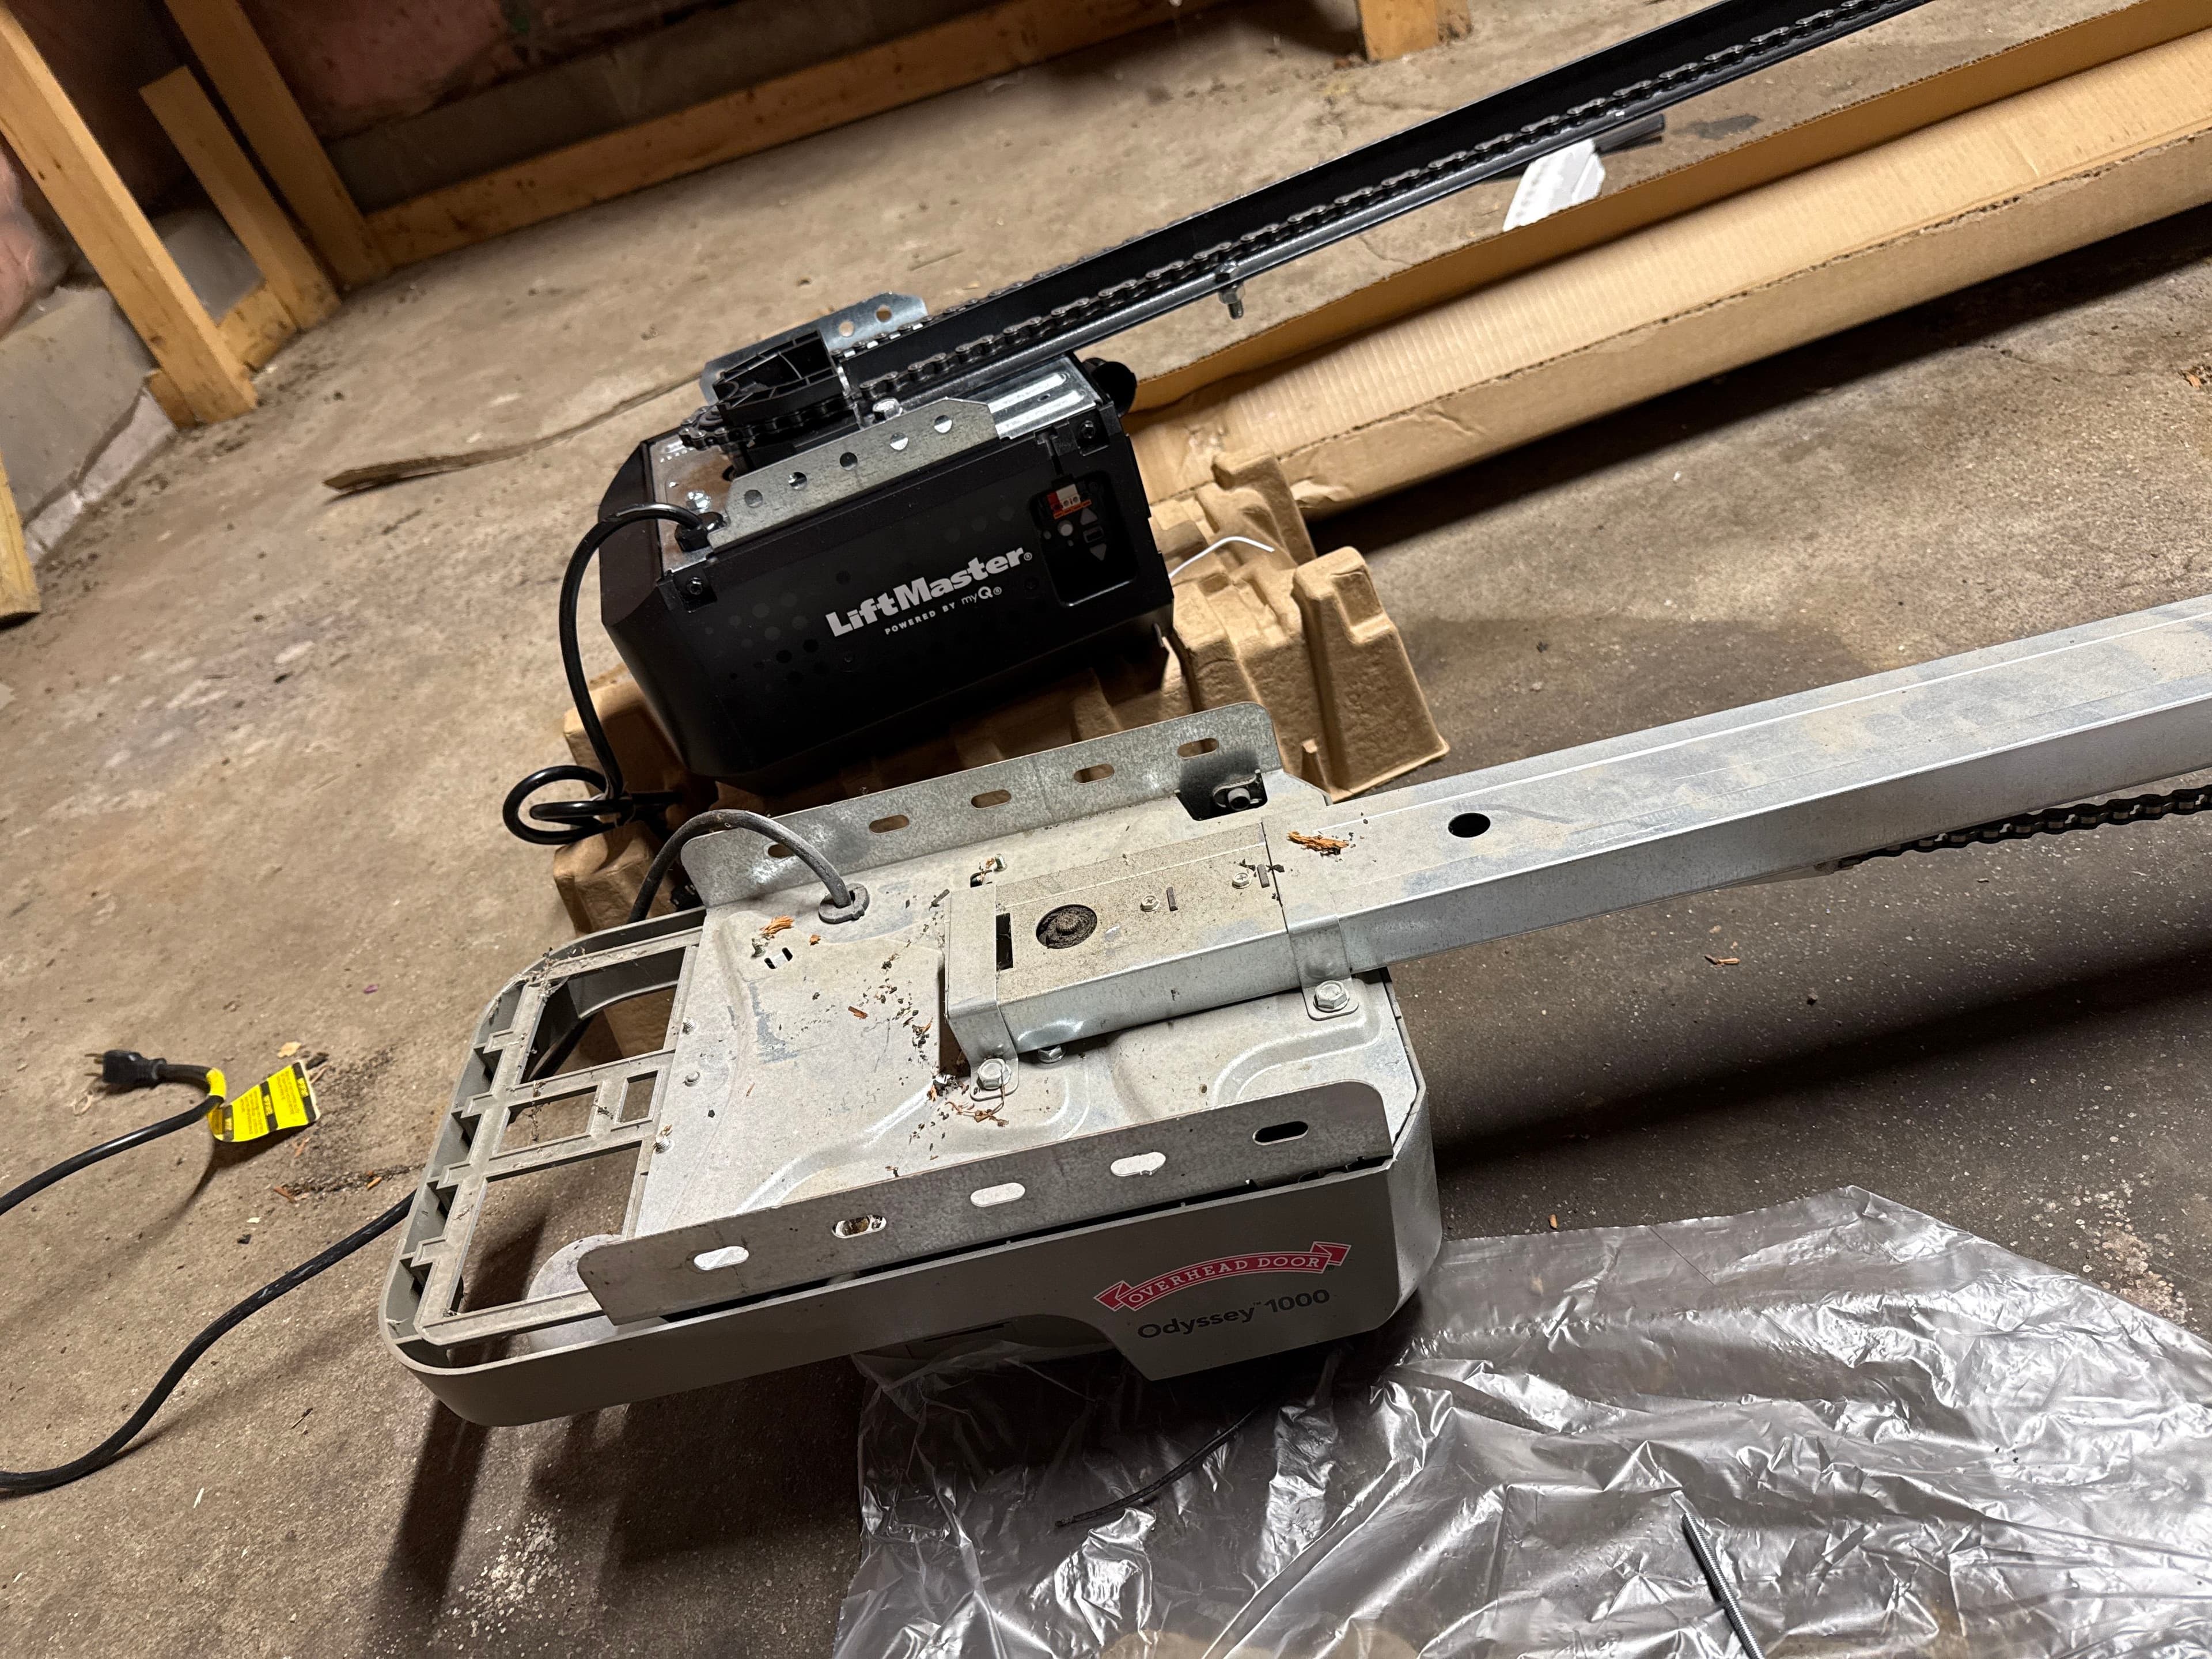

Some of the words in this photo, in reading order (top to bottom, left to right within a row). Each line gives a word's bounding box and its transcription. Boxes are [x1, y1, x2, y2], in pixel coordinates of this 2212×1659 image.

[884, 609, 936, 635] POWERED
[942, 601, 956, 613] BY
[1128, 1260, 1248, 1303] OVERHEAD
[1257, 1256, 1320, 1268] DOOR
[1265, 1289, 1330, 1313] 1000
